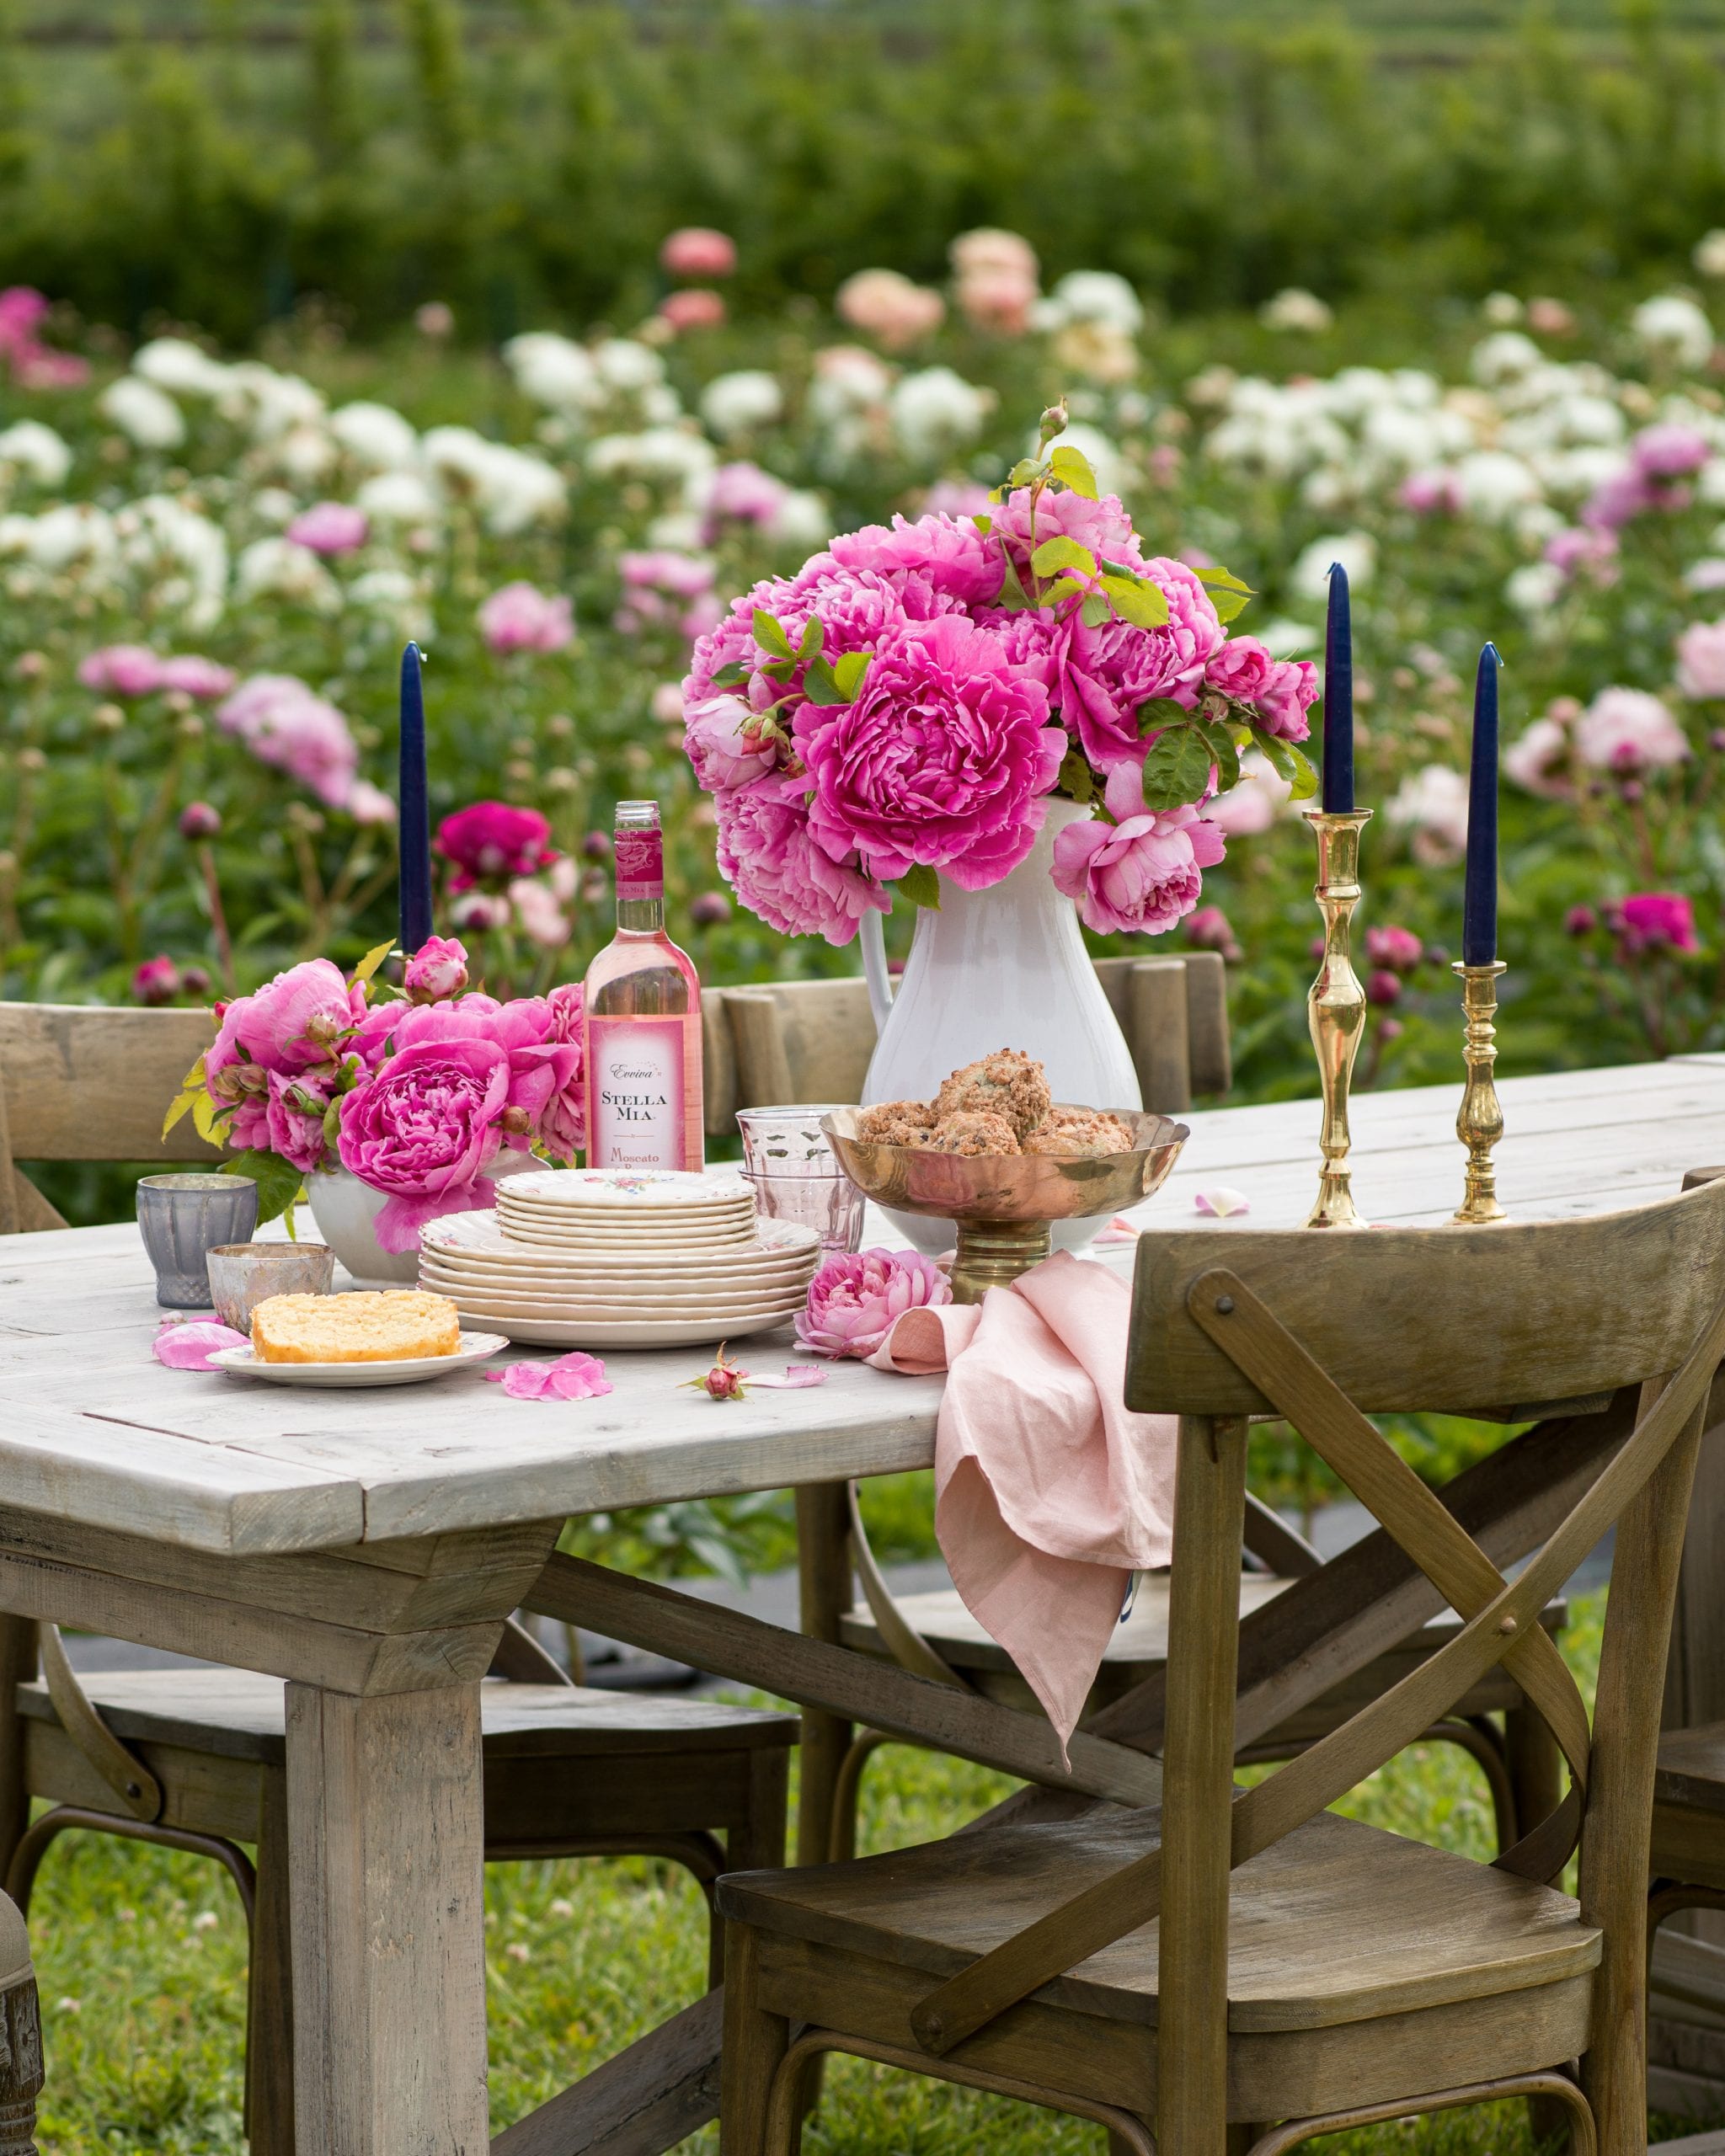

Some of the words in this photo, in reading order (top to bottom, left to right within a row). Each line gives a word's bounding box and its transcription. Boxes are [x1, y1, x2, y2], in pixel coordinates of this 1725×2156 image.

[610, 1064, 654, 1080] Evviva
[601, 1091, 667, 1105] STELLA
[617, 1107, 653, 1120] MIA
[611, 1147, 660, 1162] Moscato
